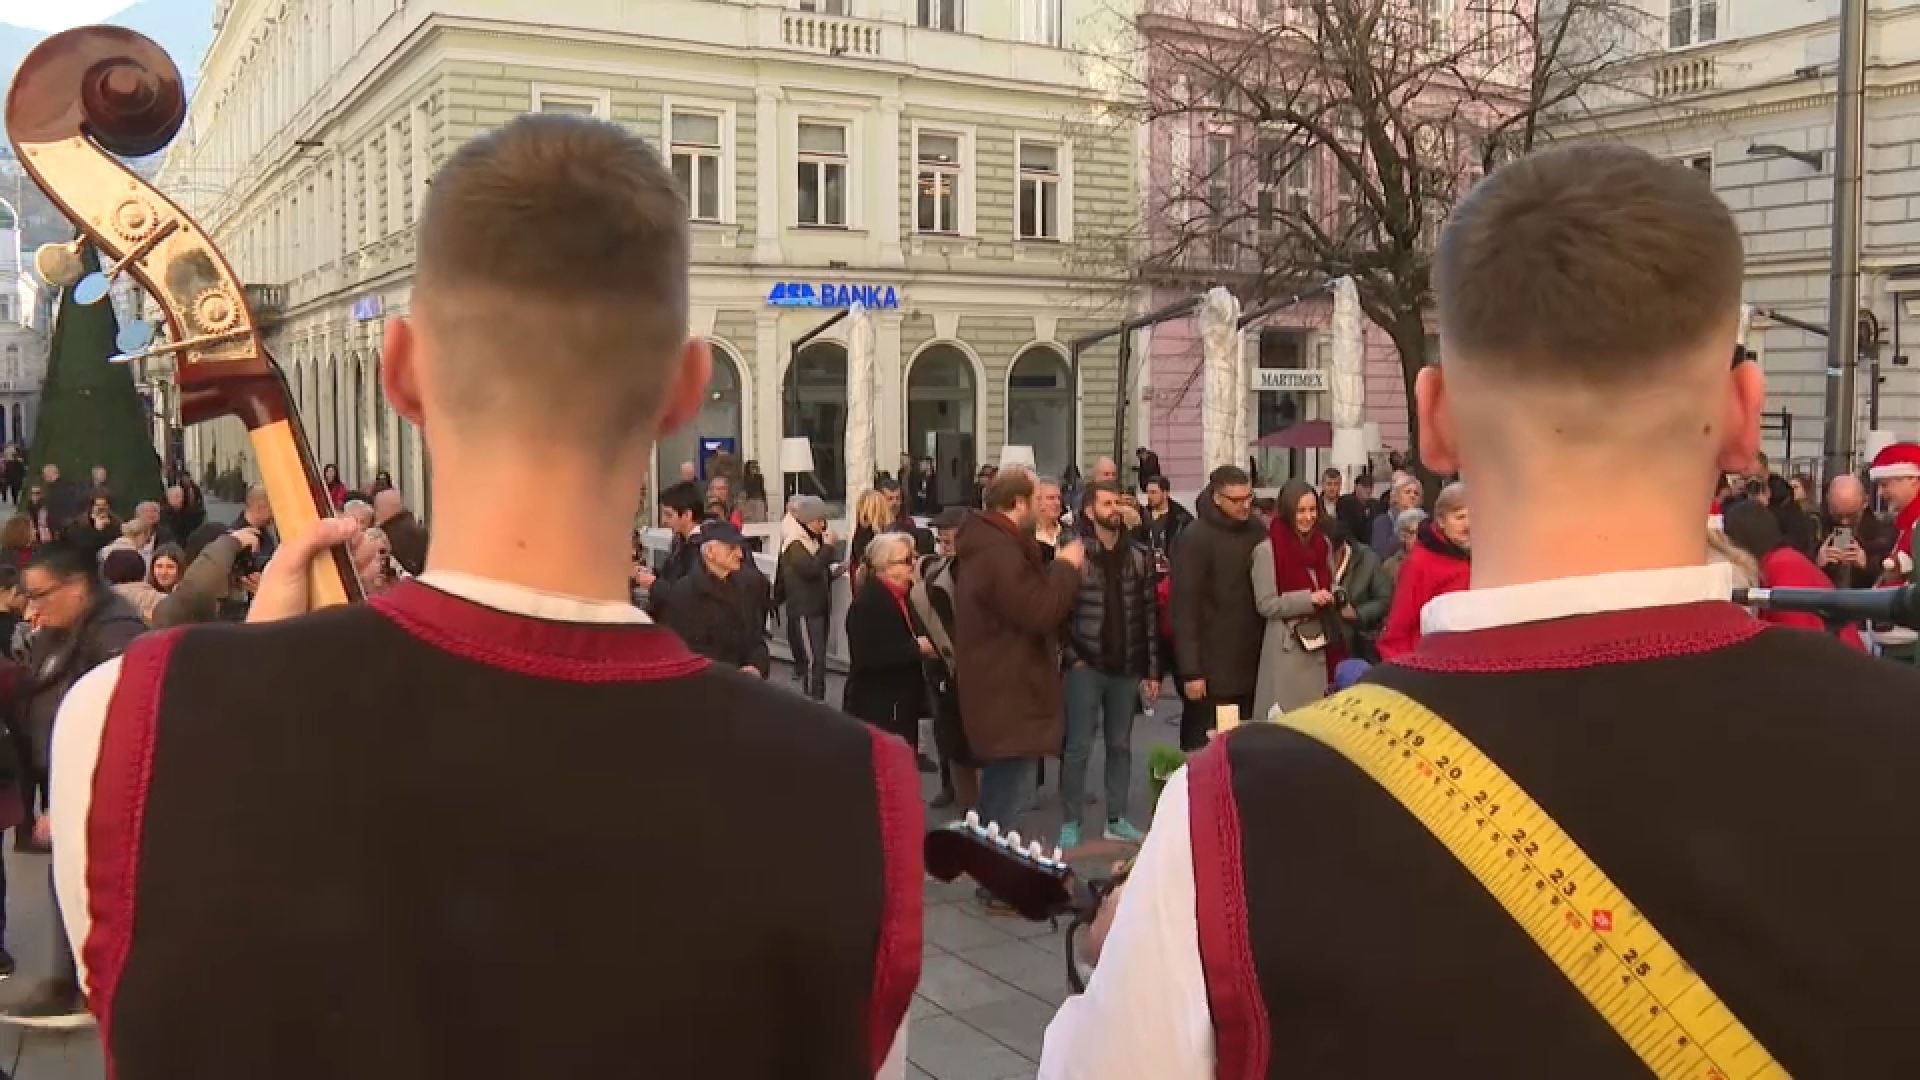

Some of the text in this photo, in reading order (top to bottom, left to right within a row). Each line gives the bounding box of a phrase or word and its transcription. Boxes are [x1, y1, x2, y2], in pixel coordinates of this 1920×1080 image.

[821, 284, 898, 308] BANKA
[1261, 373, 1323, 387] MARTIMEX
[1371, 707, 1391, 723] 18
[1403, 728, 1425, 747] 19
[1435, 755, 1462, 779] 20
[1474, 789, 1501, 816] 21
[1511, 827, 1539, 857] 22
[1549, 868, 1577, 897] 23
[1623, 949, 1651, 977] 25
